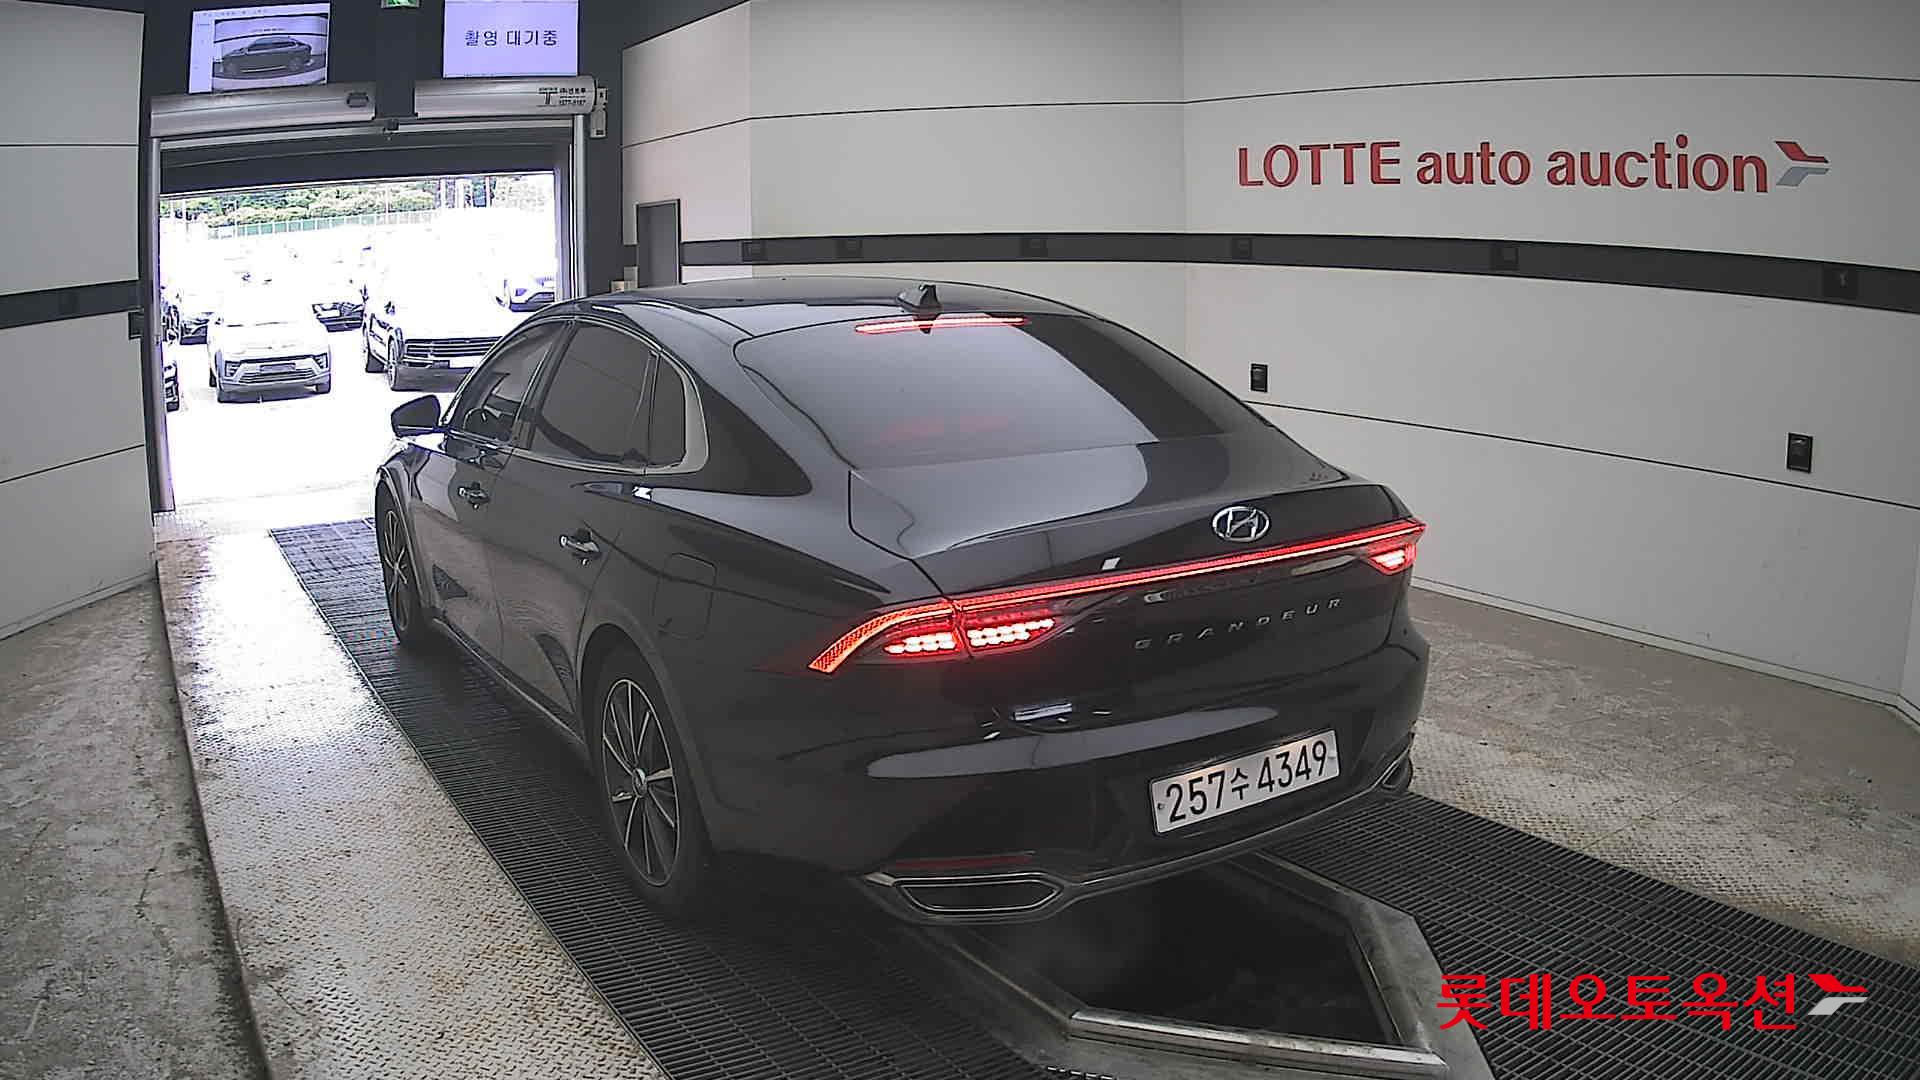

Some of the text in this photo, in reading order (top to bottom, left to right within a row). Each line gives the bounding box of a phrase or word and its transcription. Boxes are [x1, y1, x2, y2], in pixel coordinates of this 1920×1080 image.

[464, 29, 558, 47] 촬영 대기중
[1238, 133, 1770, 193] LOTTE auto auction
[1134, 598, 1341, 650] GRANDEUR
